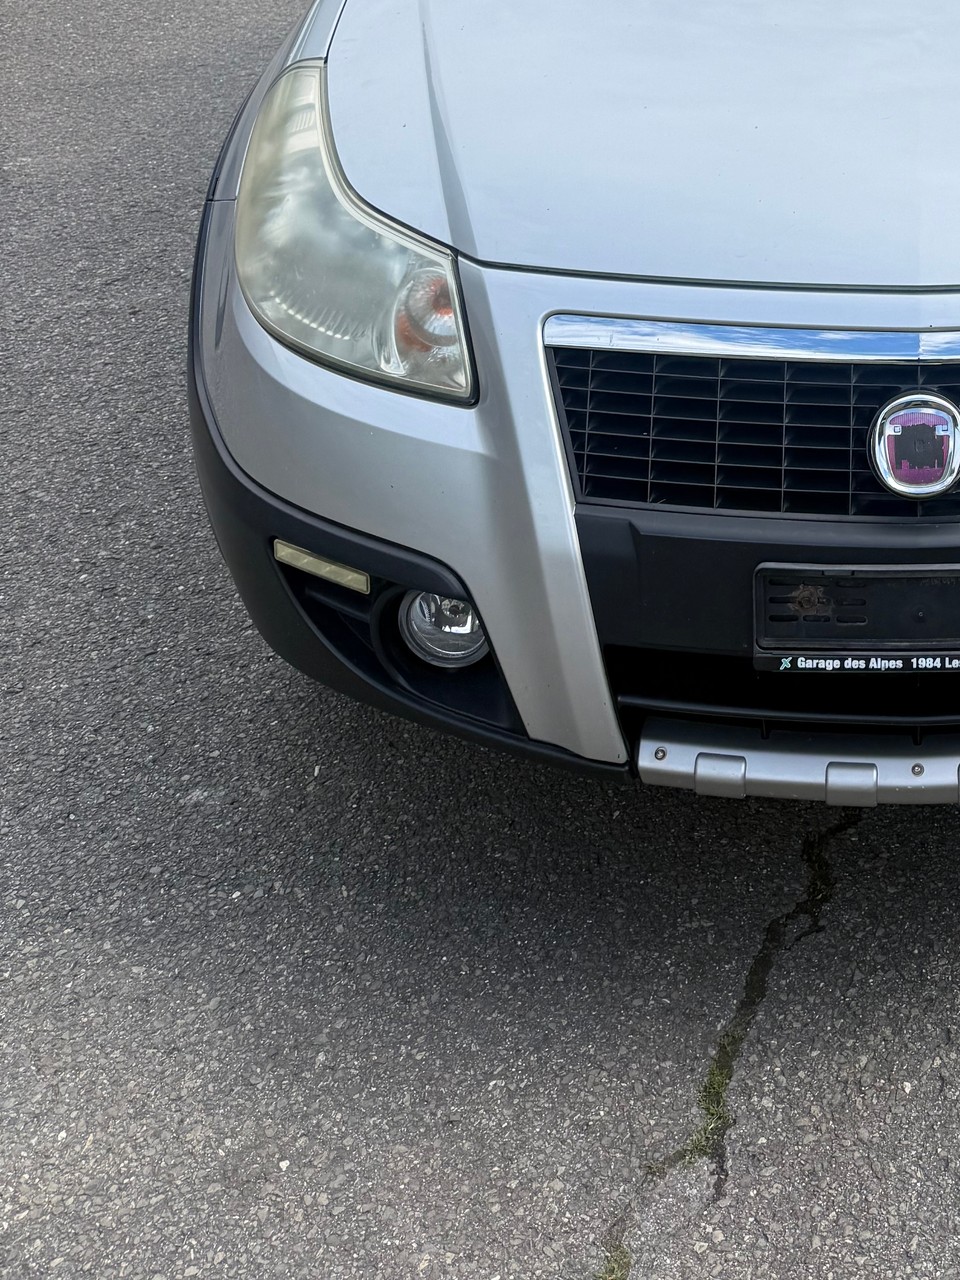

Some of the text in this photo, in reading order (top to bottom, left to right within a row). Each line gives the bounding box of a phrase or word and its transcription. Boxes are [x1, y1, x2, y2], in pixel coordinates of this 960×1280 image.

[797, 657, 841, 671] Garage
[844, 657, 866, 669] des
[869, 657, 904, 671] Alpes
[911, 657, 942, 669] 1984
